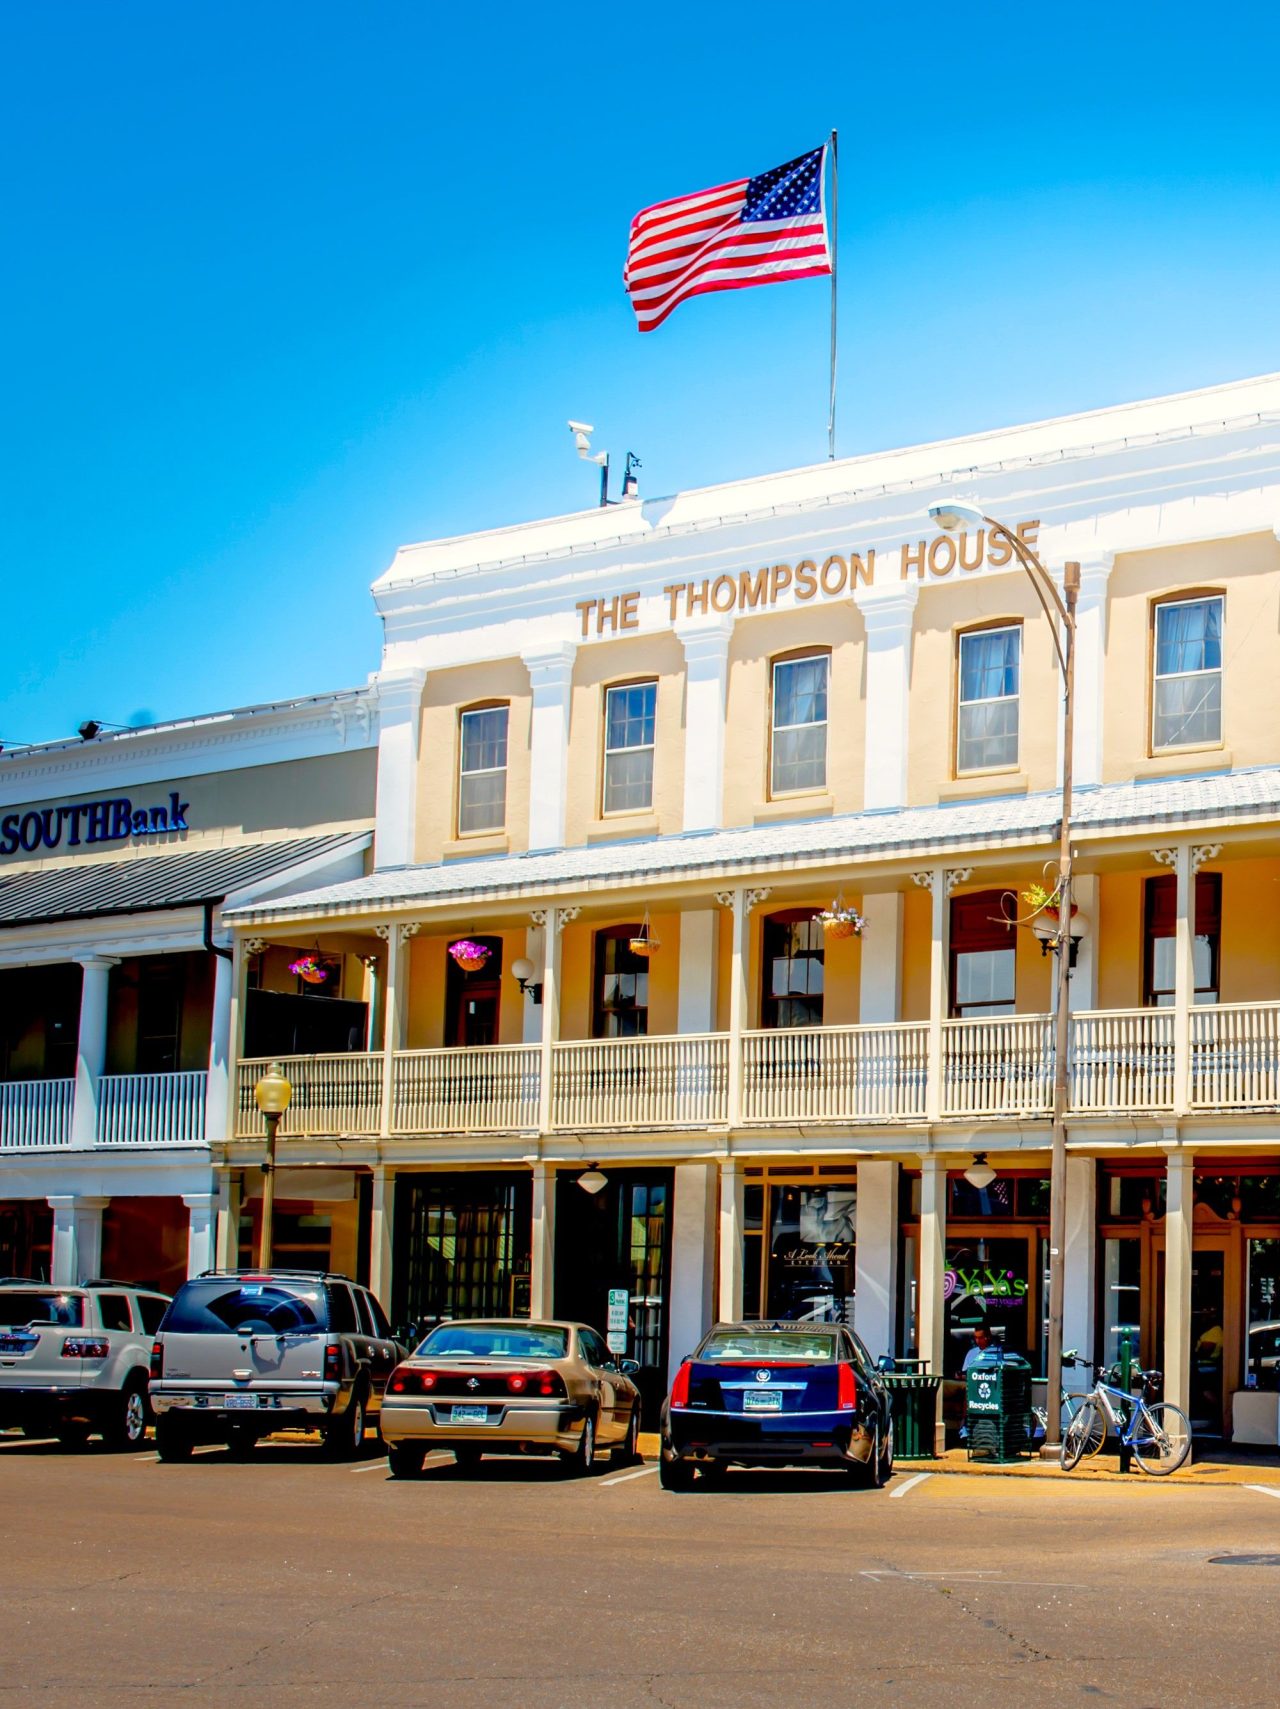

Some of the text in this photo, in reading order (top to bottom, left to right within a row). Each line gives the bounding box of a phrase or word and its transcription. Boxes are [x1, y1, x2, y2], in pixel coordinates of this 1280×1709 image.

[575, 519, 1041, 636] THE THOMPSON HOUSE
[971, 1372, 997, 1381] Oxford
[969, 1400, 999, 1411] Recycles
